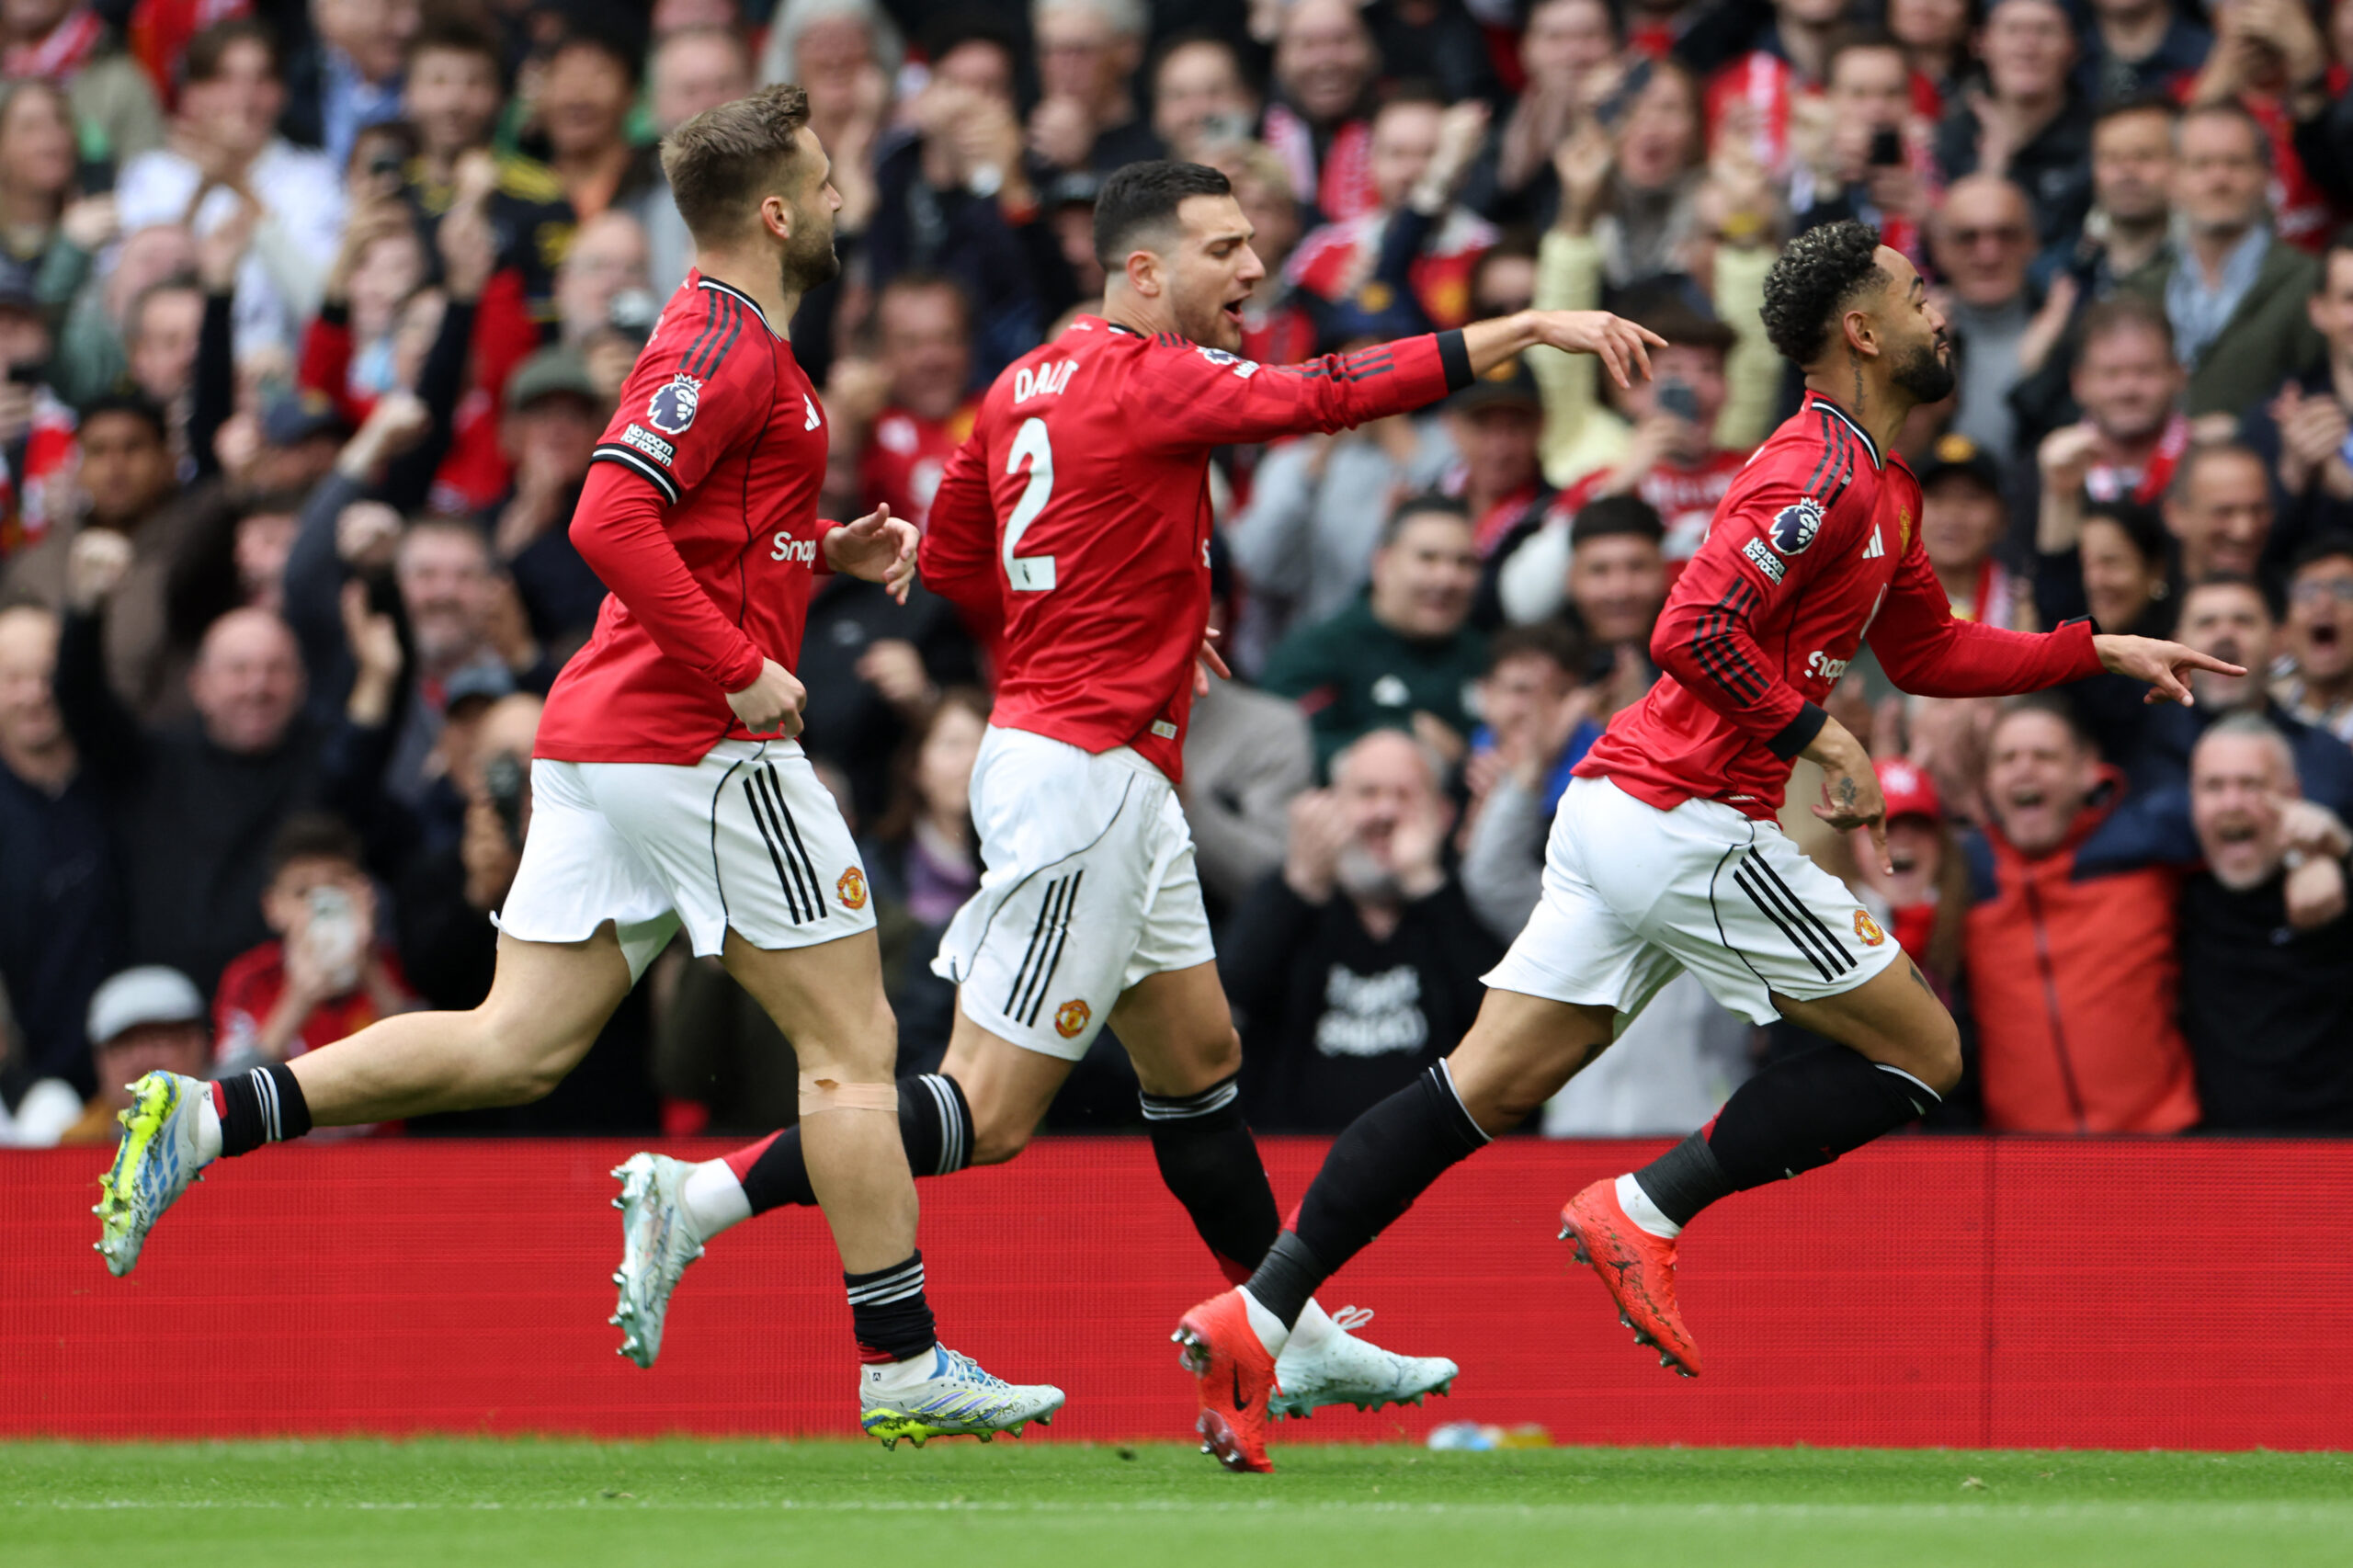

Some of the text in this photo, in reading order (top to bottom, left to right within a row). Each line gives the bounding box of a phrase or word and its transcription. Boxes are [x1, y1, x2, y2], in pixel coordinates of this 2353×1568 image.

[1014, 359, 1079, 404] DALT
[620, 433, 640, 445] for
[626, 423, 674, 456] No room
[1002, 417, 1056, 591] 2
[1742, 544, 1760, 561] for
[1748, 537, 1767, 555] No
